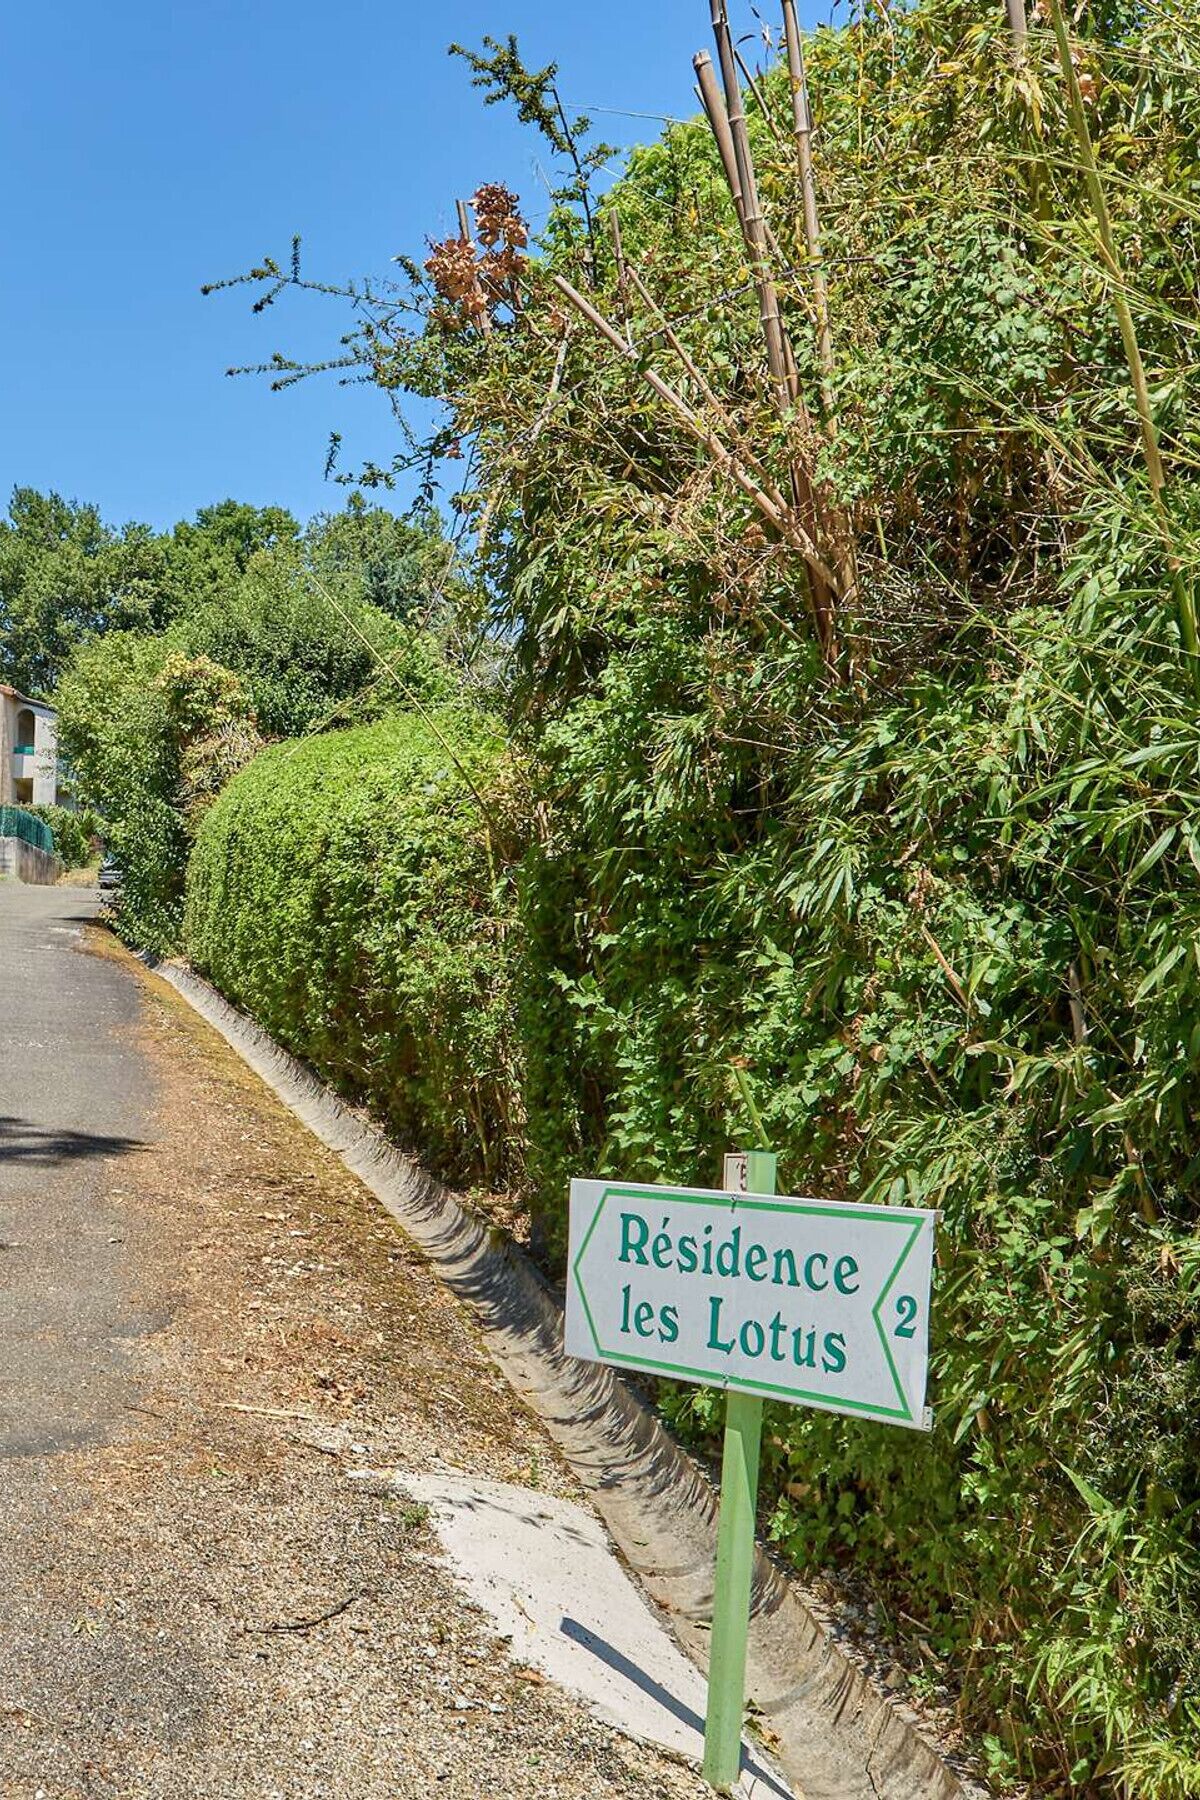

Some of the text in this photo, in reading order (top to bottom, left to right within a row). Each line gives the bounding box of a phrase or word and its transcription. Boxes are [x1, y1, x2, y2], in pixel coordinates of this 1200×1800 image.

[619, 1212, 860, 1295] Résidence
[620, 1284, 848, 1374] les Lotus
[894, 1295, 917, 1339] 2
